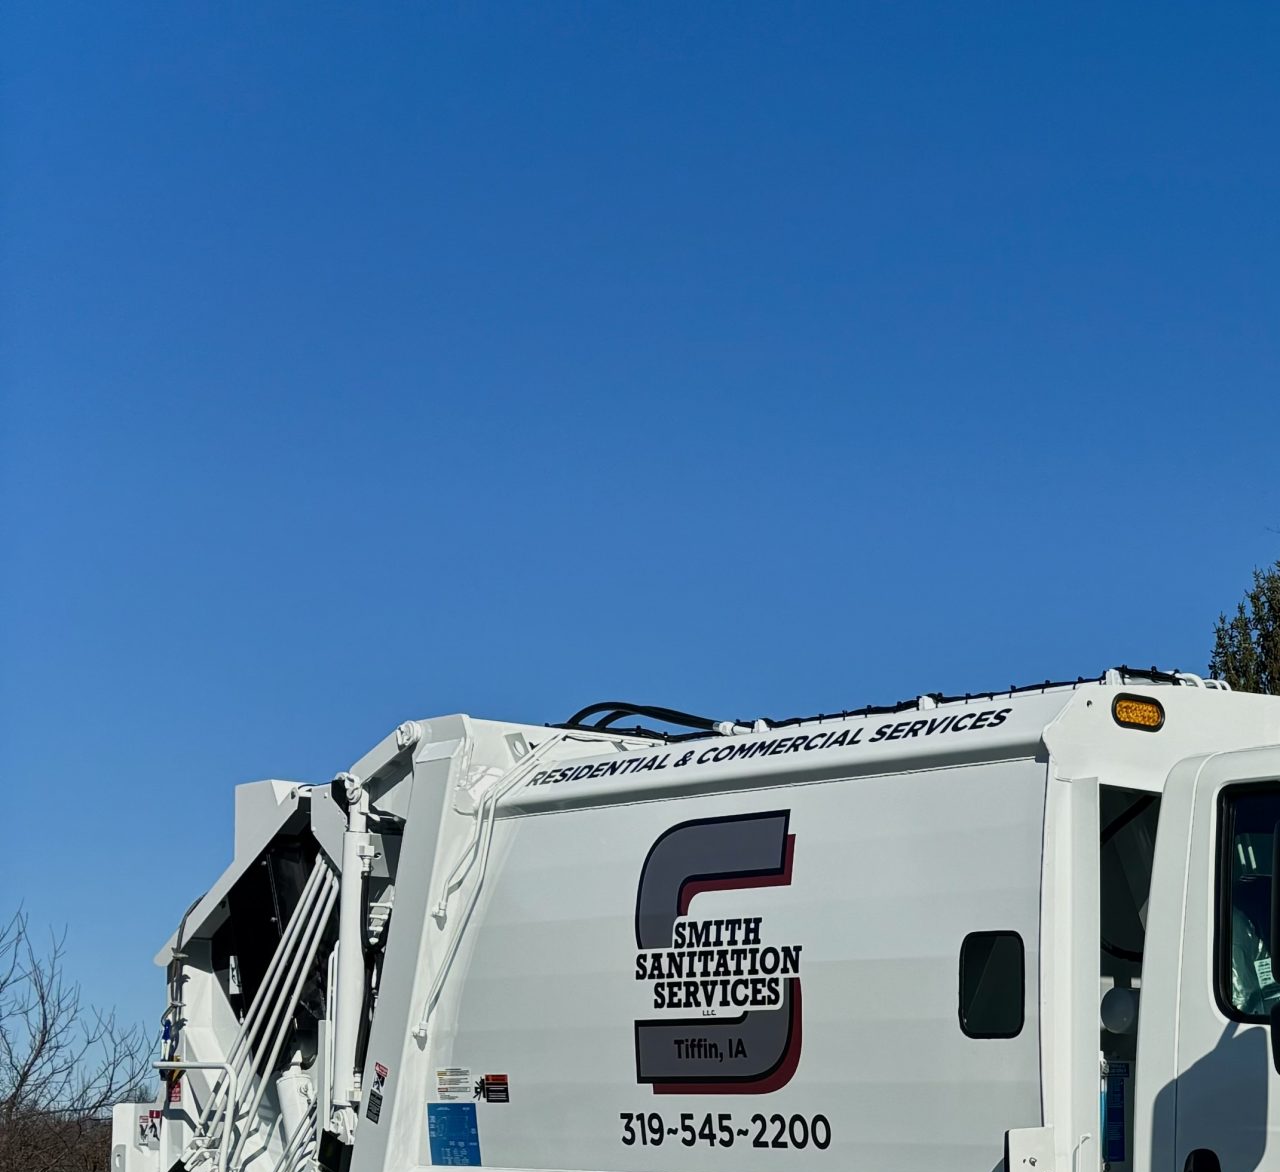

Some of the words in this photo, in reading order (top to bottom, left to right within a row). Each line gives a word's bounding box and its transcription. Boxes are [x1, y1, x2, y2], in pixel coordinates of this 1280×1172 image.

[527, 752, 670, 788] RESIDENTIAL
[674, 750, 695, 768] &
[697, 729, 863, 765] COMMERCIAL
[867, 707, 1013, 744] SERVICES
[673, 917, 762, 949] SMITH
[636, 946, 802, 980] SANITATION
[654, 977, 781, 1009] SERVICES
[673, 1038, 724, 1062] Tiffin,
[728, 1038, 748, 1059] IA
